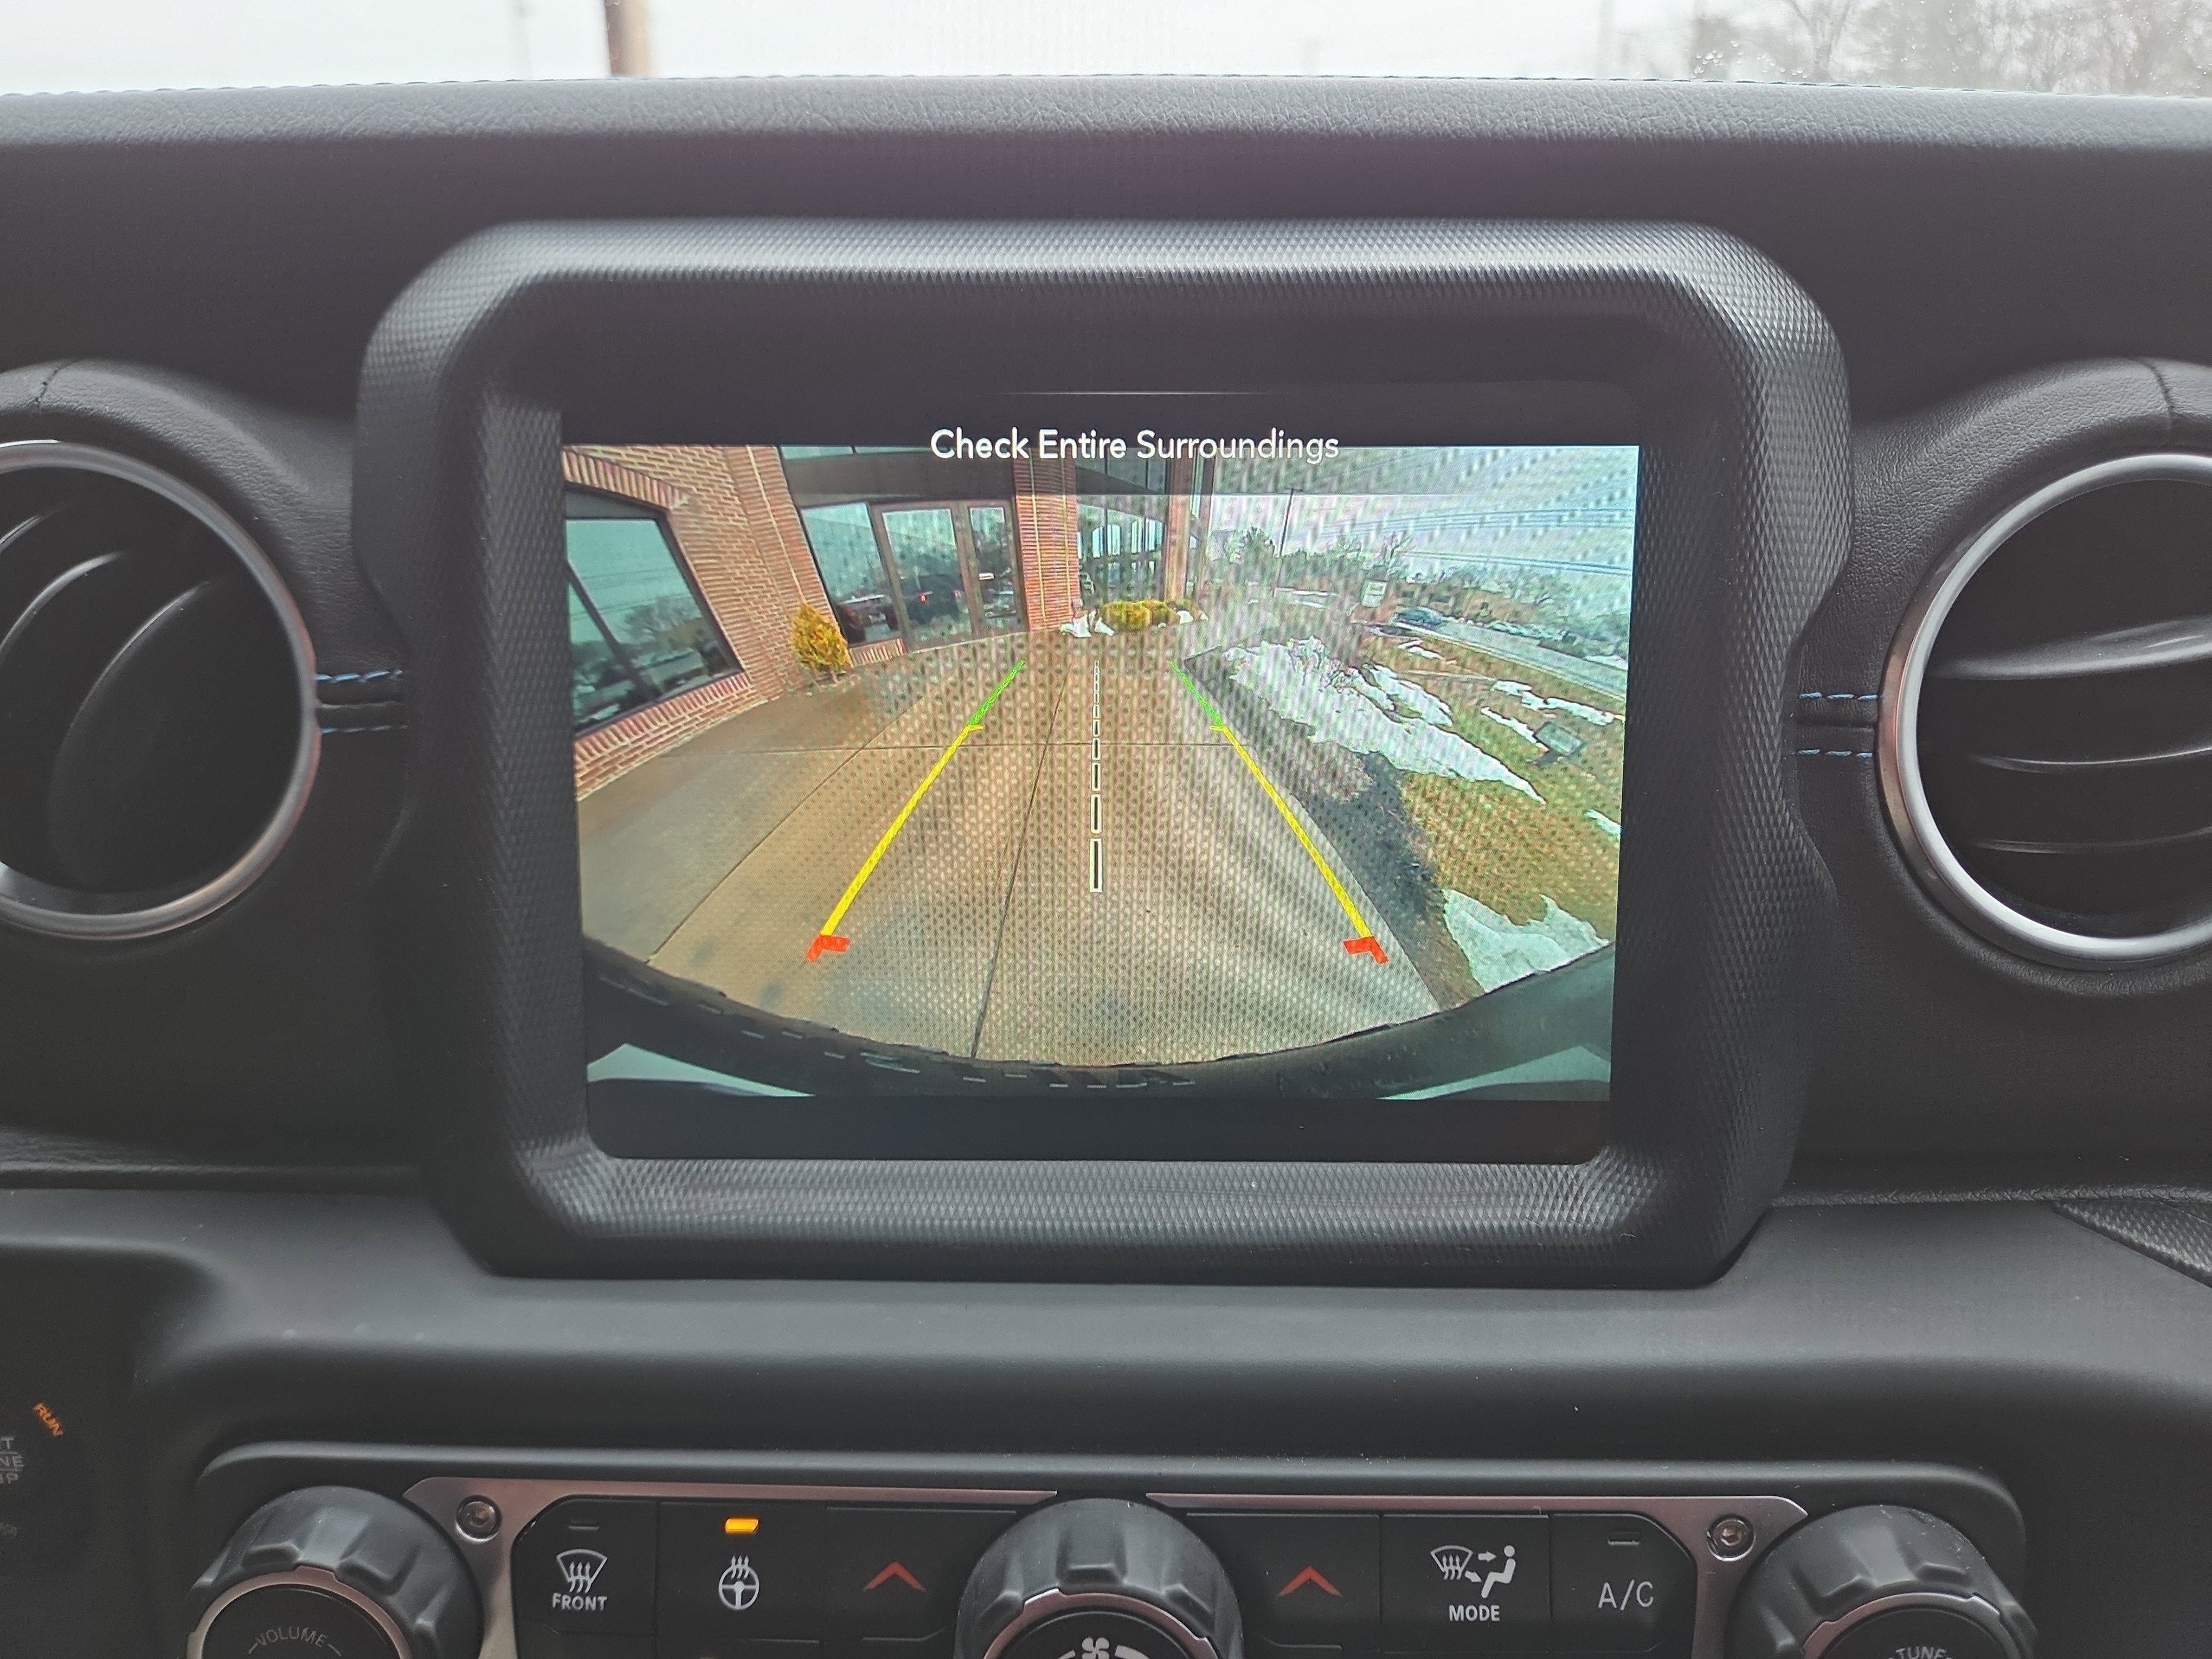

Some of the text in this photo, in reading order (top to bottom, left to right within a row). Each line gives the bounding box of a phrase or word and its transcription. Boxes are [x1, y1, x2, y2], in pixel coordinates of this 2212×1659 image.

[930, 427, 1340, 465] Check Entire Surroundings
[33, 1402, 64, 1437] RUN
[551, 1592, 608, 1612] FRONT
[1598, 1579, 1654, 1611] A/C
[1449, 1604, 1500, 1622] MODE
[255, 1626, 329, 1648] VOLUME
[1895, 1646, 1946, 1659] TUNE
